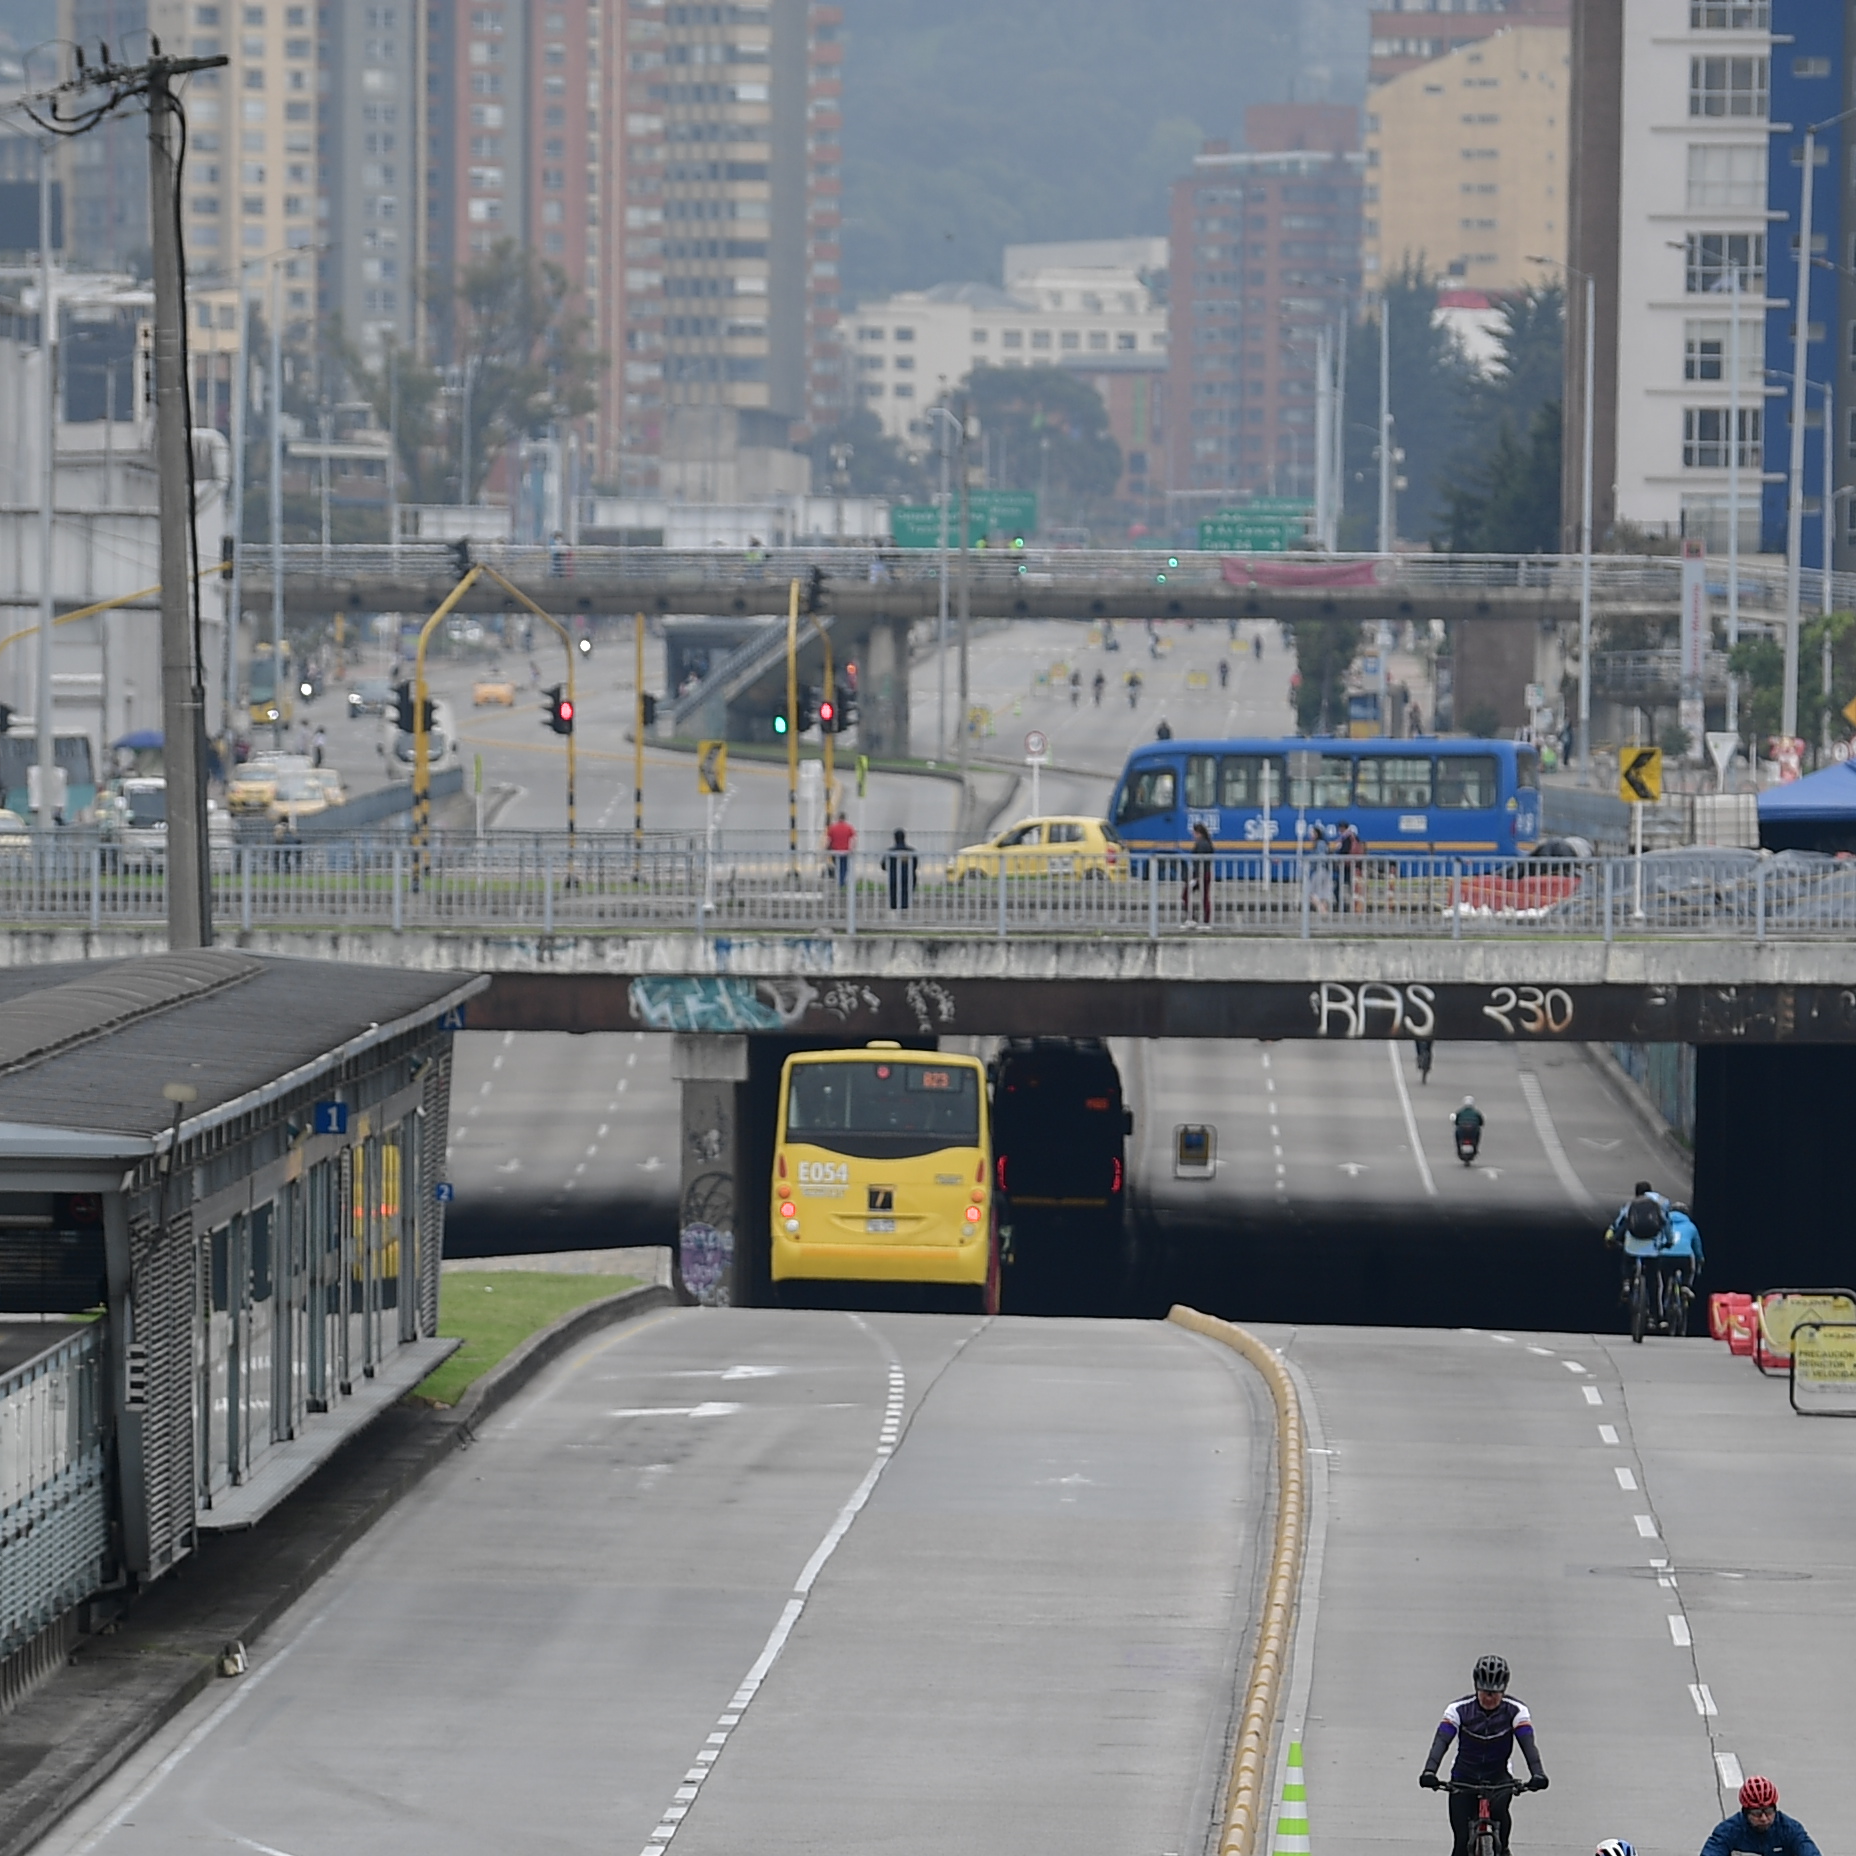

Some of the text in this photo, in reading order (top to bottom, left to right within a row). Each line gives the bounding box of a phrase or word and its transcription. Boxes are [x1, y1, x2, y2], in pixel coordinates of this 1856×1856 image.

[444, 1008, 463, 1028] A
[1319, 981, 1574, 1037] RAS 230
[326, 1105, 340, 1132] 1
[797, 1161, 849, 1182] E054
